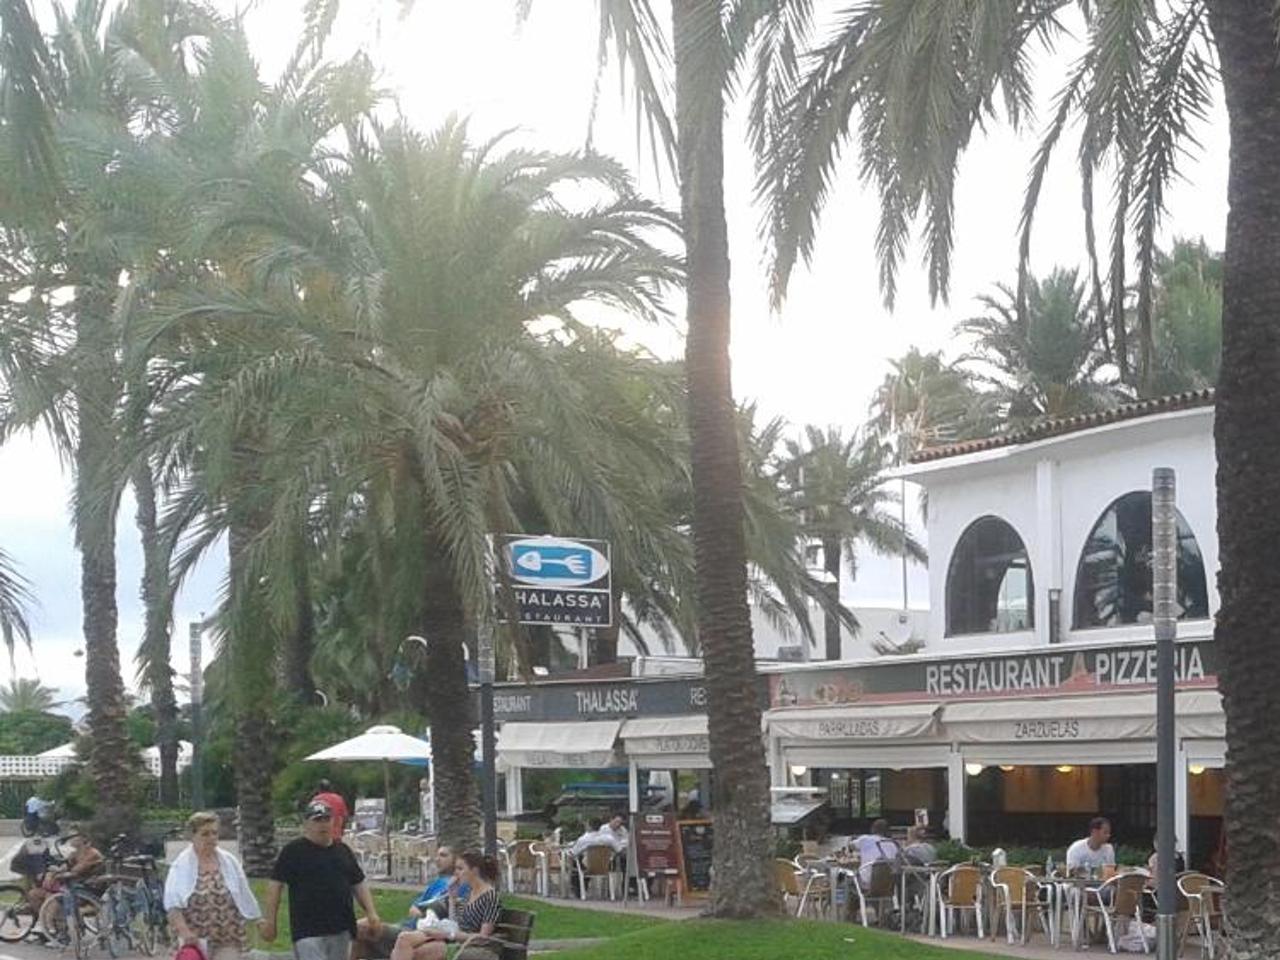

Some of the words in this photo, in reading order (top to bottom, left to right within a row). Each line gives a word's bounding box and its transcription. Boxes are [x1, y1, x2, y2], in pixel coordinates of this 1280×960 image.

[514, 591, 602, 609] HALASSA
[926, 656, 1064, 694] RESTAURANT
[1095, 647, 1204, 684] PIZZEIA
[576, 690, 638, 712] THALASSA
[1015, 719, 1080, 738] ZARZUELAS
